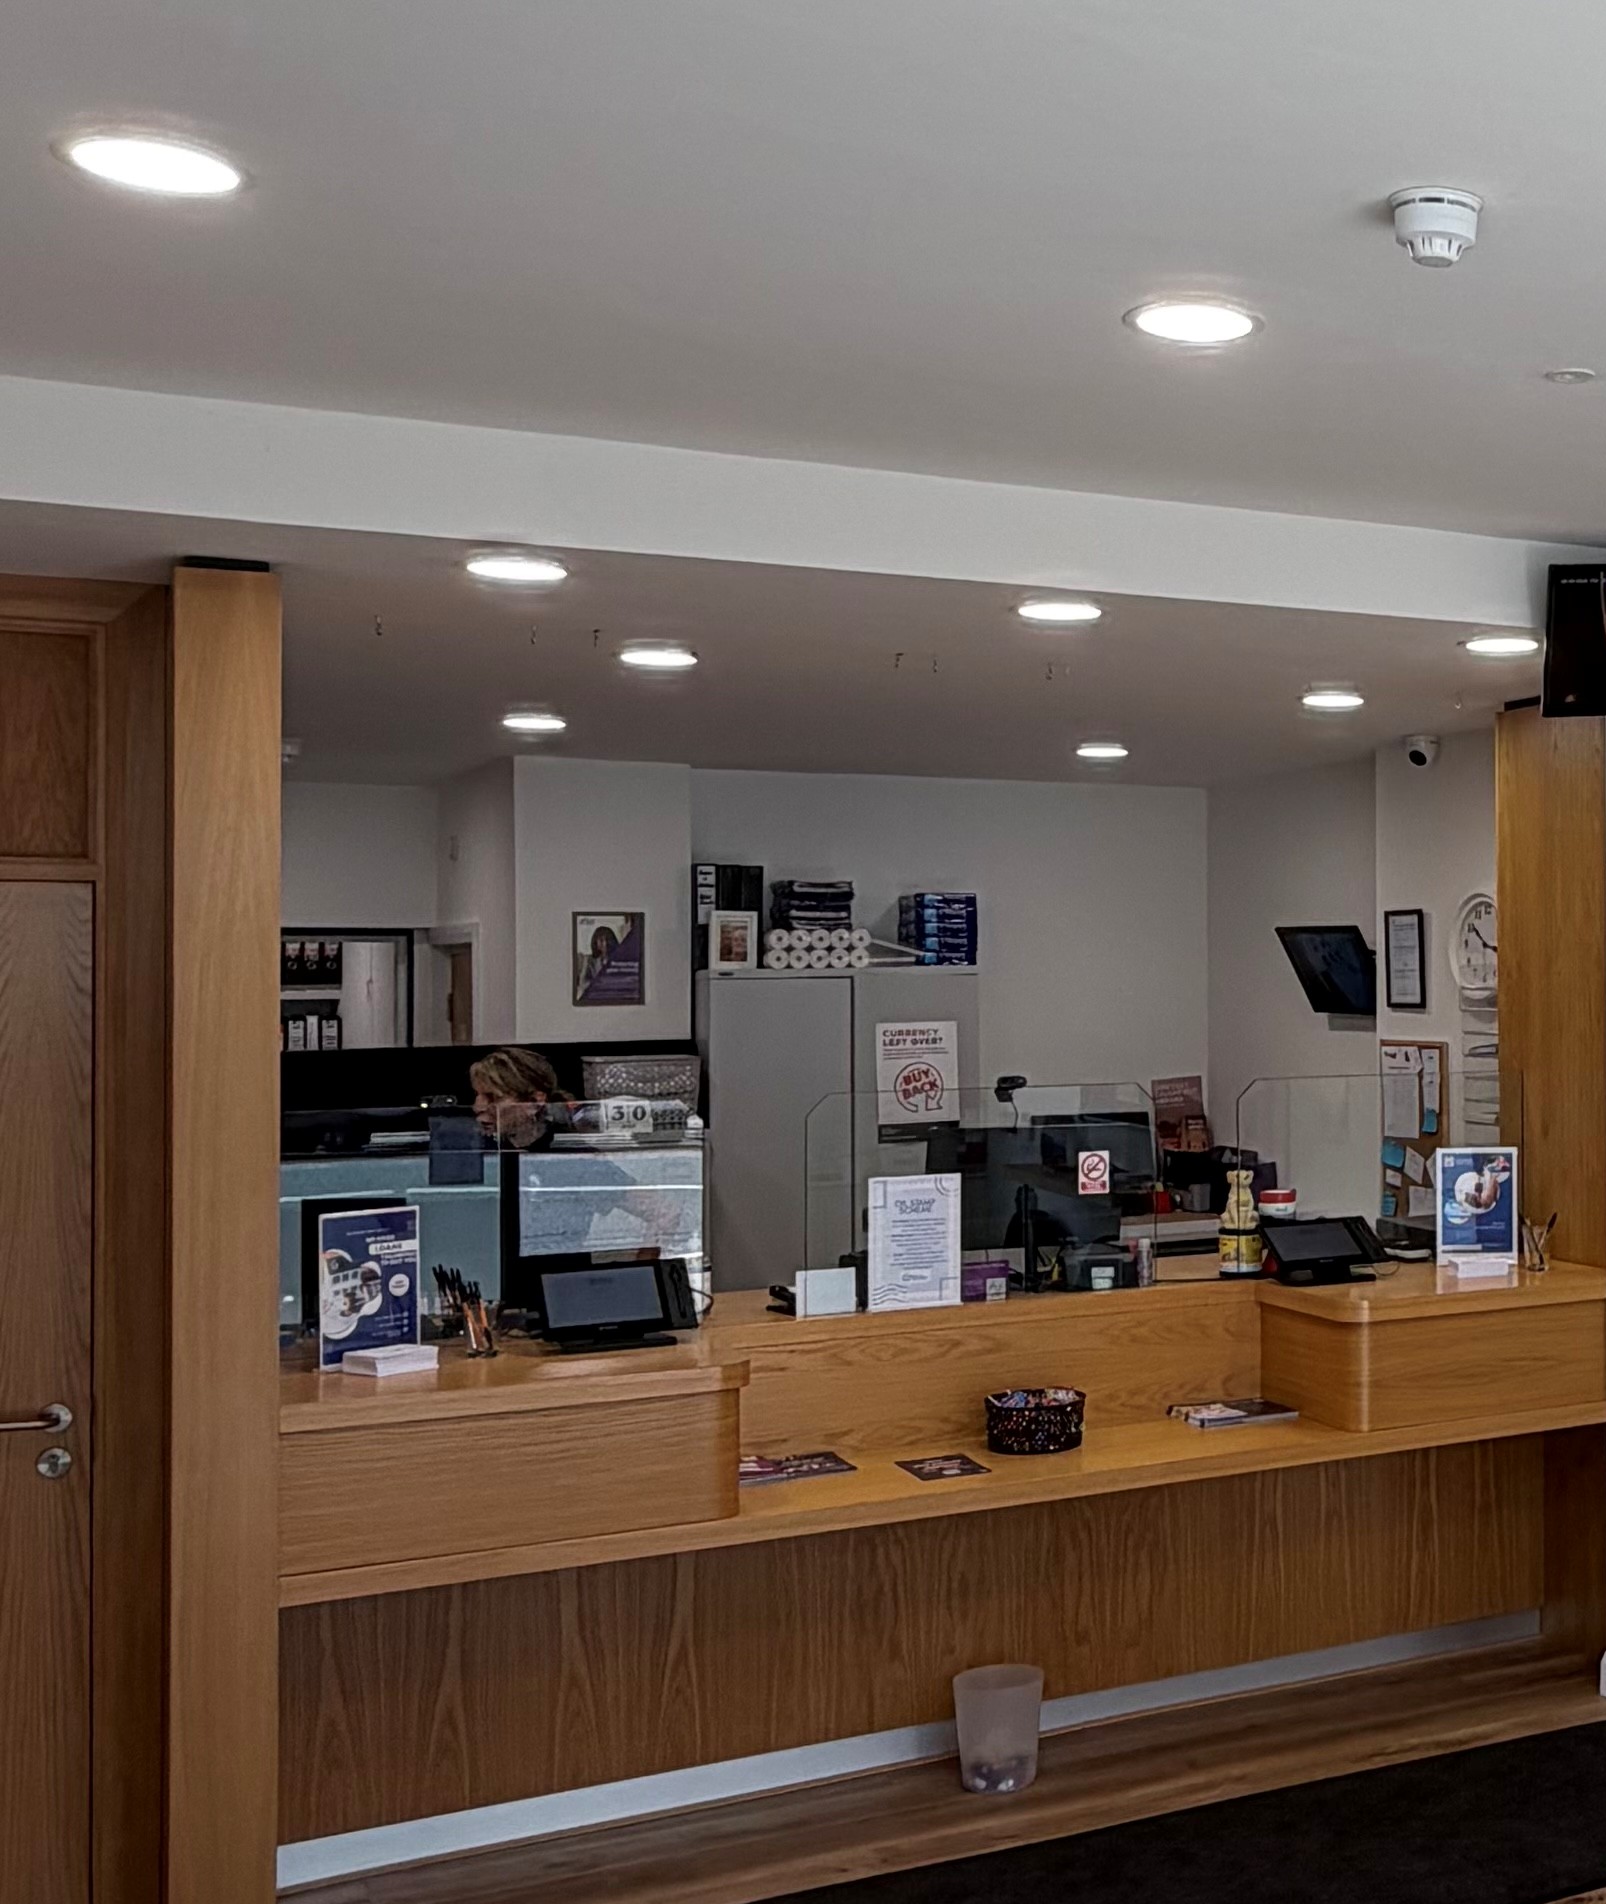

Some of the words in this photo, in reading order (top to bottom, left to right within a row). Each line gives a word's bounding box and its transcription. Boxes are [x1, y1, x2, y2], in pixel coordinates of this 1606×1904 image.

[883, 1029, 938, 1037] CURRENCY
[883, 1038, 908, 1047] LEFT
[911, 1037, 943, 1045] OVER?
[903, 1068, 930, 1086] BUY
[902, 1079, 939, 1100] BACK
[611, 1105, 647, 1121] 30
